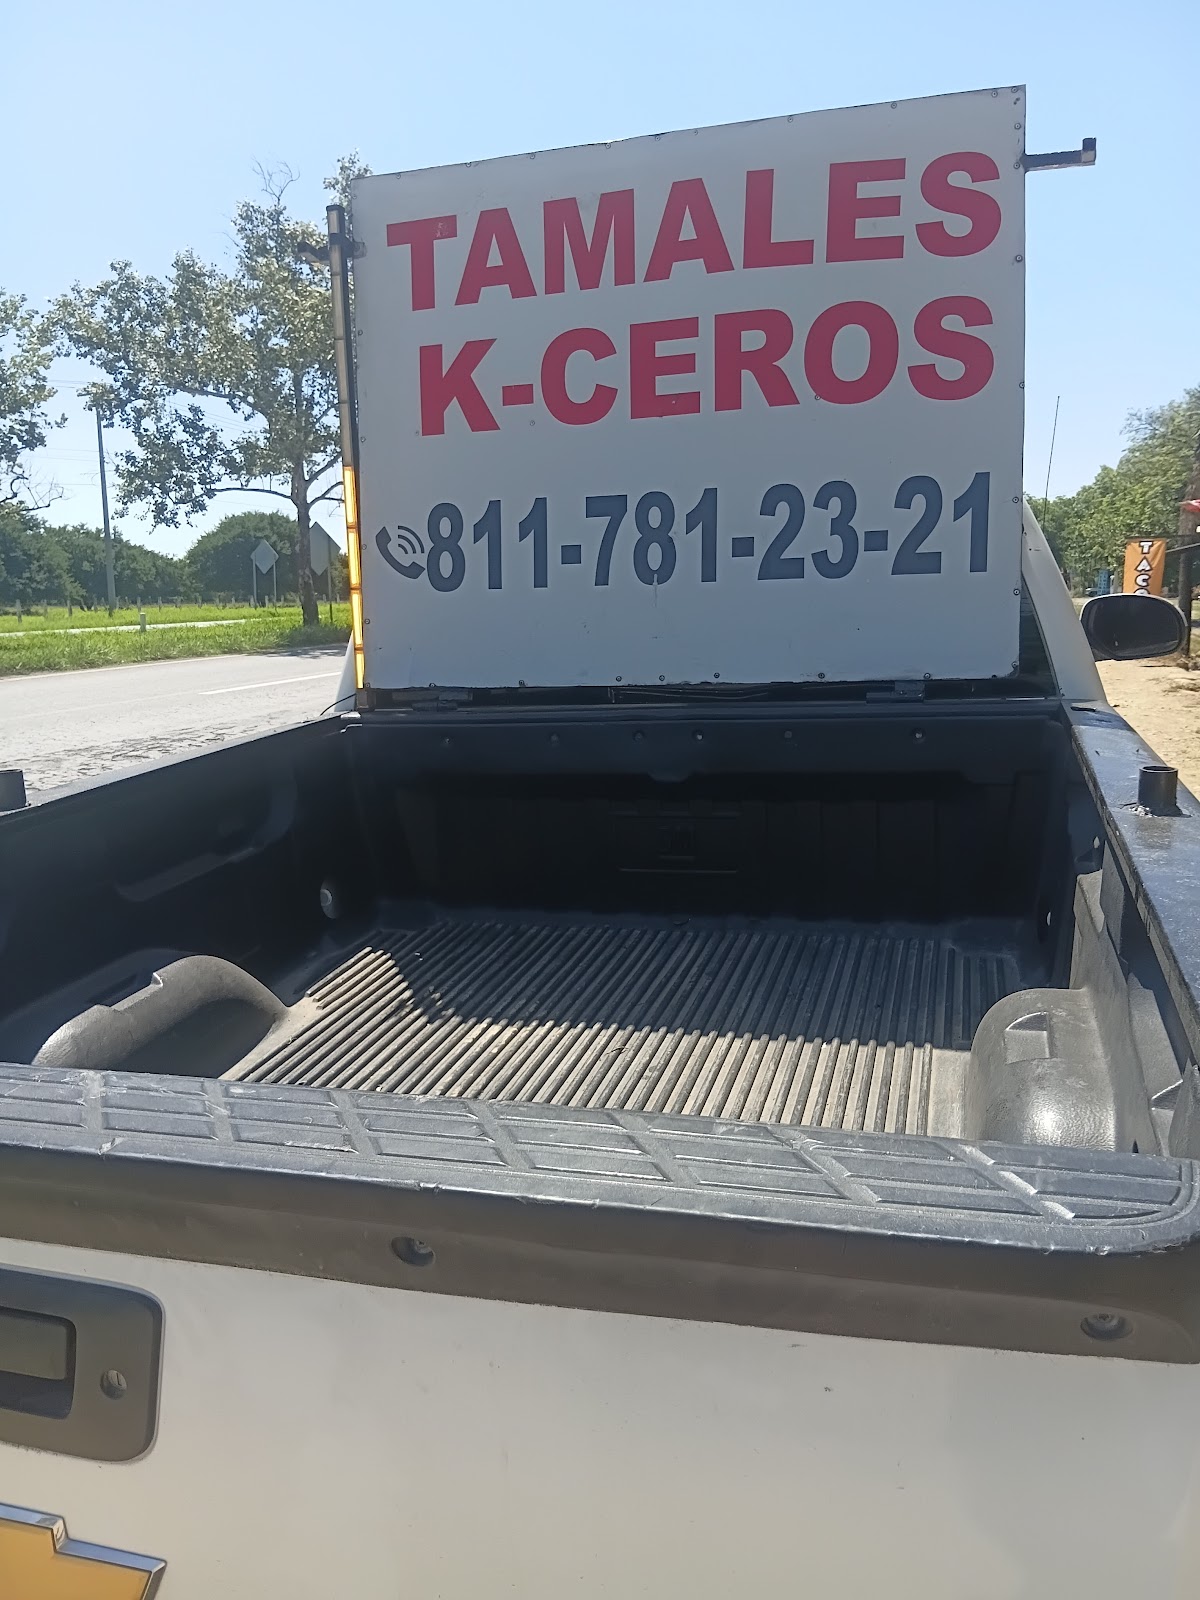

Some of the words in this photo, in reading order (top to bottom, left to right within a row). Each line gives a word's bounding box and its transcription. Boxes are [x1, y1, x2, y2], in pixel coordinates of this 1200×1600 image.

[386, 152, 1002, 312] TAMALES
[419, 295, 995, 437] K-CEROS
[427, 472, 992, 592] 811-781-23-21
